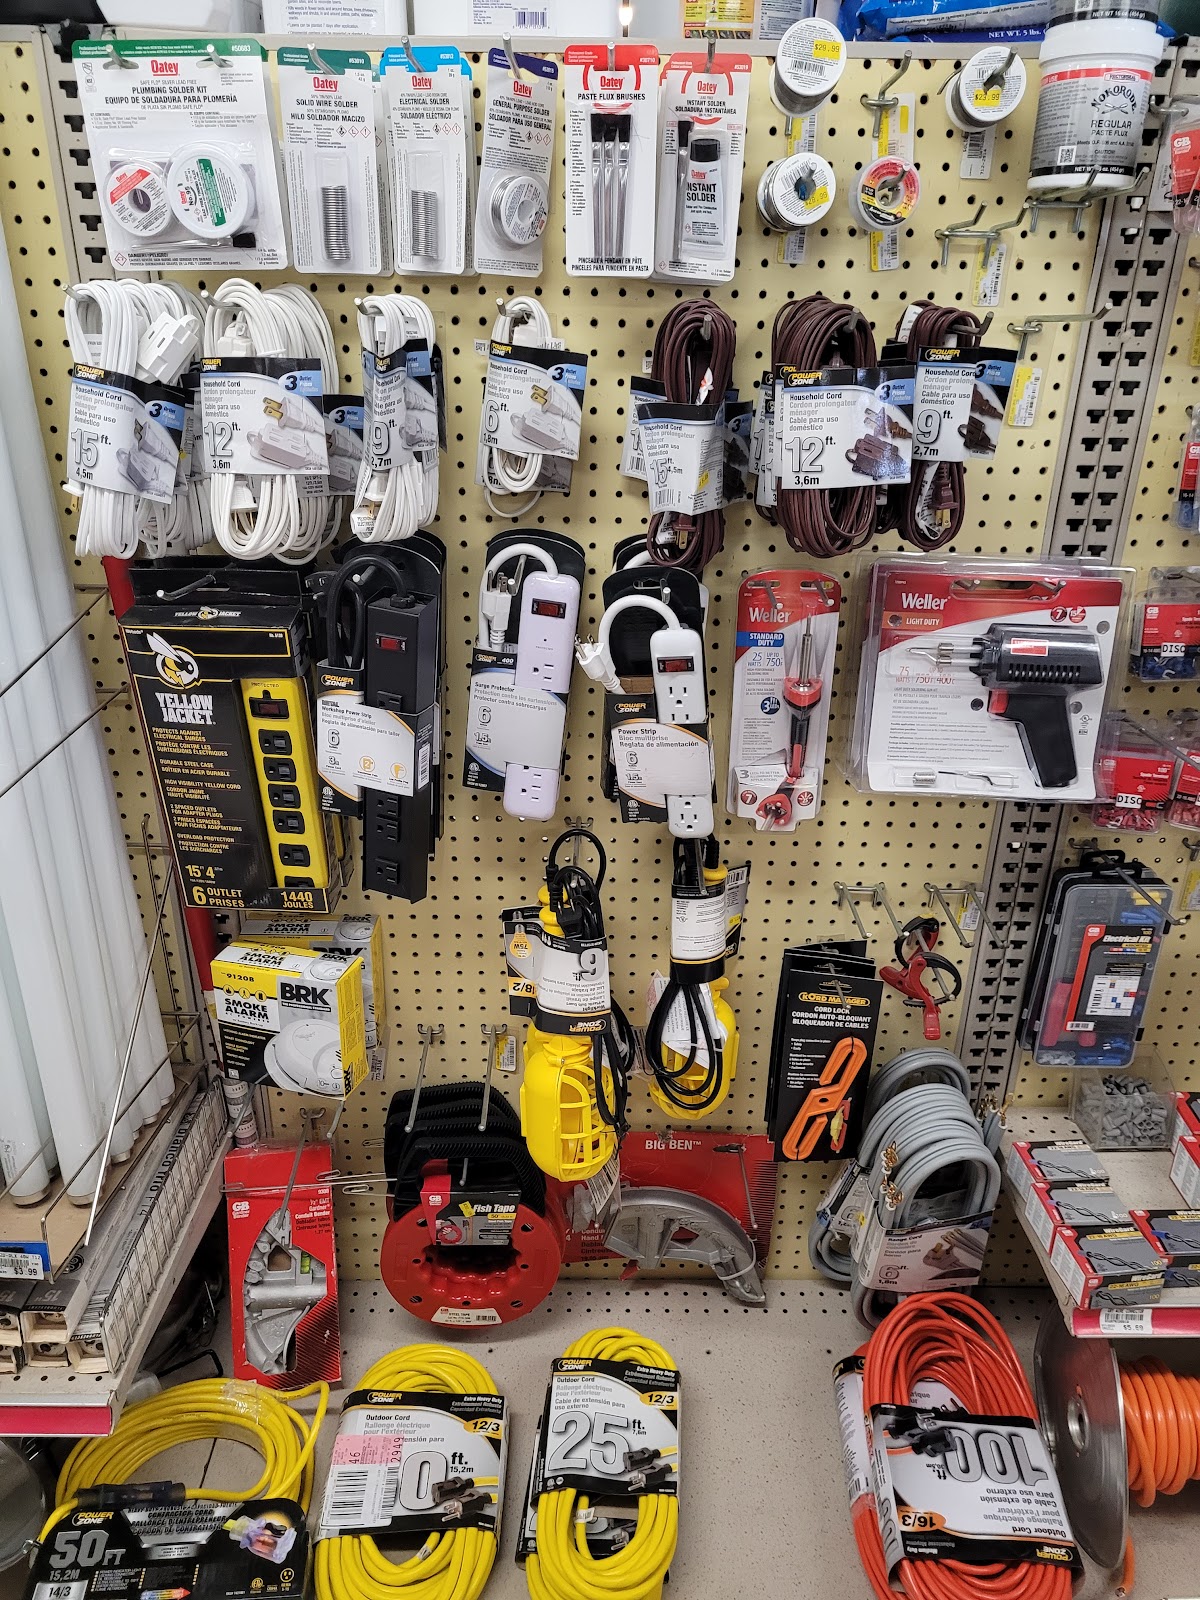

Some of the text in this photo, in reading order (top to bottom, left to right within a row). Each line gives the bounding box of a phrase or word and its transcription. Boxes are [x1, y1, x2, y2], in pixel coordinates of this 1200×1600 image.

[988, 31, 1003, 39] NET
[151, 60, 179, 76] Oatey
[314, 77, 338, 91] Oatey
[412, 76, 432, 89] Oatey
[600, 76, 623, 89] Oatey
[697, 81, 717, 94] Oatey
[513, 81, 532, 97] Oatey
[203, 93, 237, 103] PLOMERÍA
[493, 100, 550, 116] GENERAL PURPOSE SOLDER
[704, 106, 737, 114] INSTANTÁNEA
[307, 114, 340, 122] SOLDADOR
[430, 110, 451, 119] ELÉCTRICO
[489, 114, 511, 123] SOLDADOR
[512, 116, 523, 124] PARA
[535, 120, 551, 130] GENERAL
[1091, 120, 1132, 129] REGULAR
[1174, 137, 1191, 147] GB
[687, 192, 715, 202] SOLDER
[929, 349, 960, 357] POWER
[77, 365, 104, 378] POWER
[77, 371, 96, 380] ZONE
[975, 363, 986, 379] 3
[791, 372, 822, 381] POWER
[76, 385, 122, 401] Household Cord
[789, 393, 825, 401] Household
[149, 403, 162, 417] 3
[484, 400, 509, 433] 6 ft.
[808, 417, 823, 425] para
[917, 409, 953, 444] 9 ft.
[204, 422, 240, 456] 12 ft.
[72, 428, 111, 467] 15 ft.
[914, 446, 939, 456] 2,7m
[785, 436, 836, 472] 12 ft.
[213, 460, 230, 469] 3,6m
[76, 467, 93, 480] 4,5m
[795, 476, 819, 486] 3,6m
[902, 593, 948, 610] Weller
[749, 607, 791, 622] Weller
[924, 618, 939, 626] DUTY
[155, 693, 212, 710] YELLOW
[162, 708, 214, 724] JACKET
[193, 887, 242, 904] 6 OUTLET
[281, 892, 313, 902] 1440
[209, 898, 244, 908] PRISES
[1103, 935, 1139, 943] Electrical
[226, 973, 254, 982] 9120B
[280, 982, 330, 1006] BRK
[224, 999, 268, 1012] SMOKE
[225, 1006, 269, 1020] ALARM
[819, 1014, 871, 1022] AUTO-BLOQUANT
[793, 1019, 834, 1027] BLOQUEADOR
[645, 1140, 665, 1149] BIG
[232, 1202, 249, 1211] GB
[473, 1204, 515, 1212] Fish Tape
[648, 1395, 674, 1403] 12/3
[472, 1421, 500, 1431] 12/3
[548, 1411, 645, 1474] 25 ft.
[932, 1428, 1048, 1486] 100 ft.
[986, 1488, 1016, 1496] externo
[1036, 1490, 1054, 1499] para
[980, 1496, 1020, 1504] extensión
[1034, 1499, 1057, 1507] Cable
[902, 1515, 936, 1527] 16/3
[1012, 1527, 1066, 1537] Outdoor Cord
[50, 1530, 126, 1569] 50 FT
[1042, 1546, 1066, 1554] ZONE
[1036, 1550, 1069, 1561] POWER
[50, 1569, 80, 1581] 15,2M
[49, 1587, 71, 1597] 14/3
